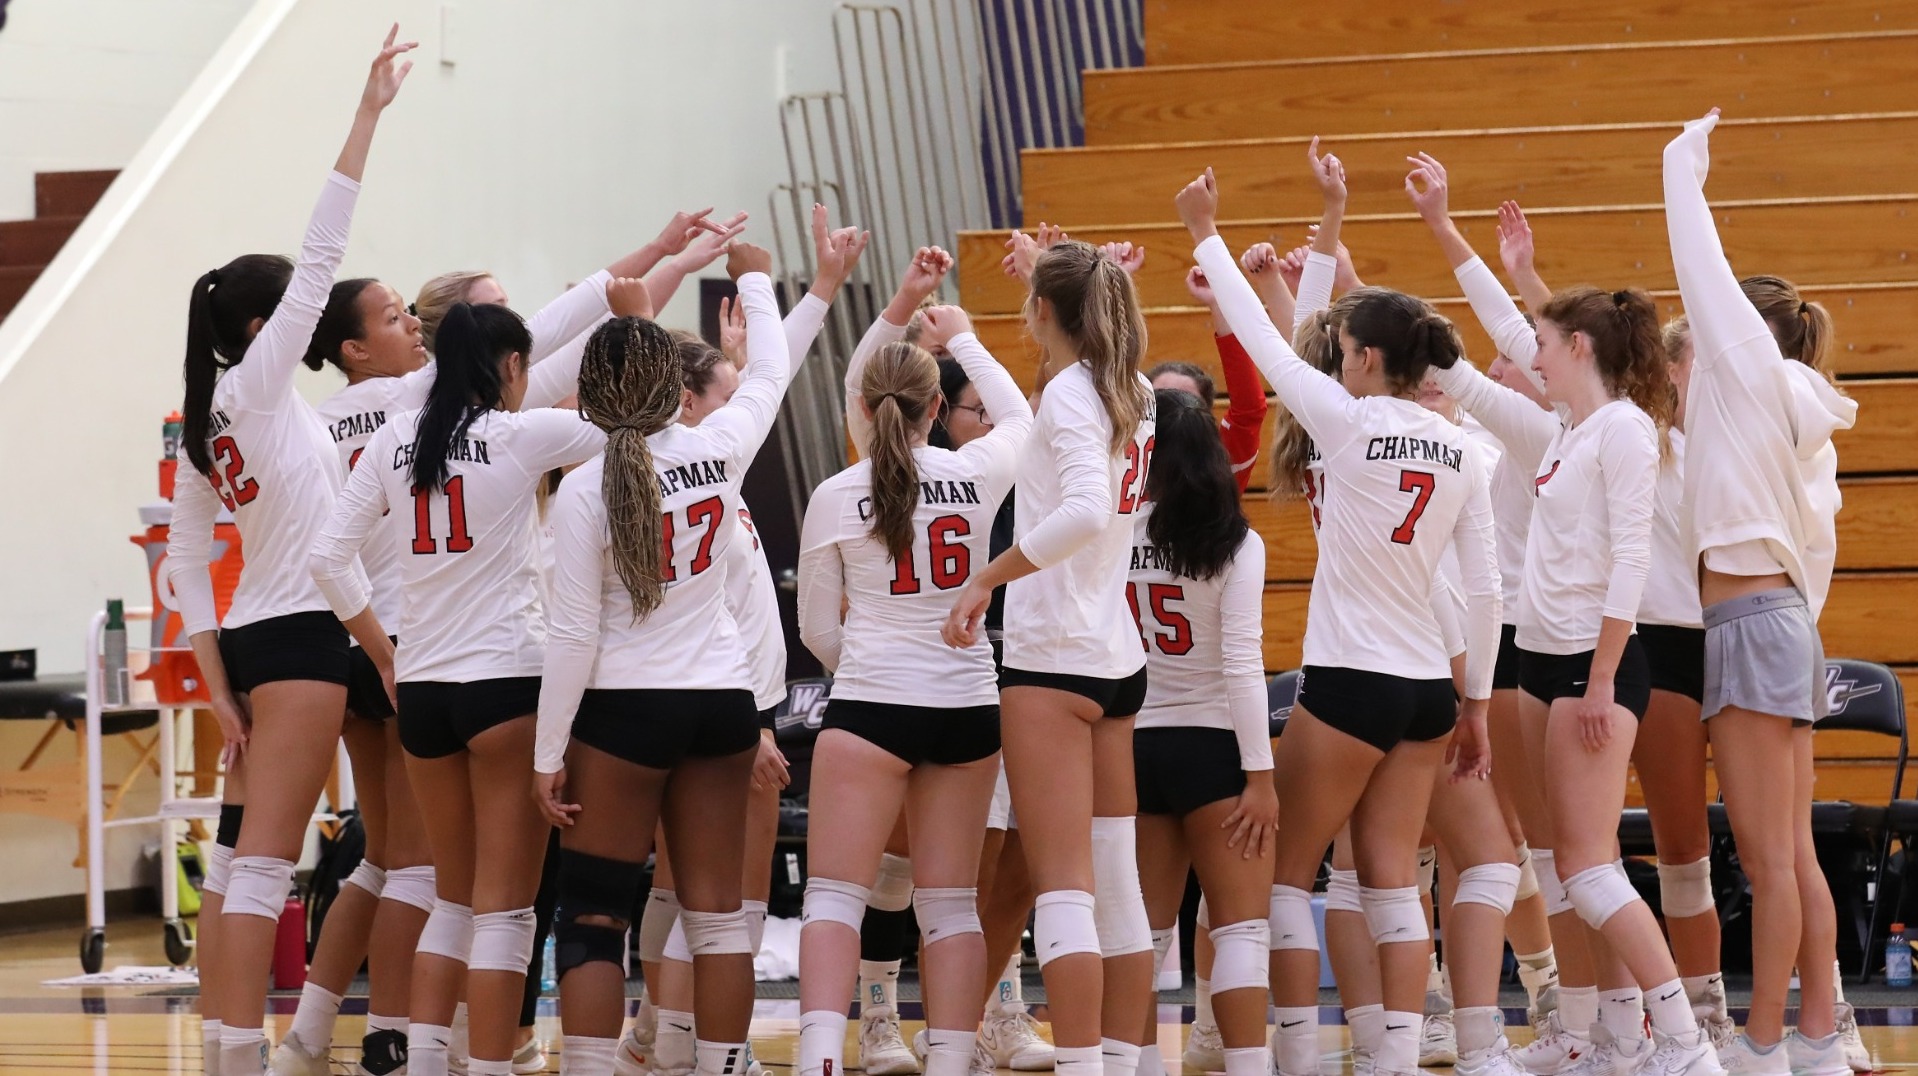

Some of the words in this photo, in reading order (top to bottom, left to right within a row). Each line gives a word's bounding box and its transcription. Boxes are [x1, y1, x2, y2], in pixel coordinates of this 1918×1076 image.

[393, 438, 491, 471] CHMAN
[1365, 436, 1463, 473] CHAPMAN
[658, 459, 728, 498] APMAN
[410, 474, 473, 554] 11
[857, 480, 980, 521] CMAN
[1390, 469, 1436, 545] 7
[889, 513, 970, 595] 16
